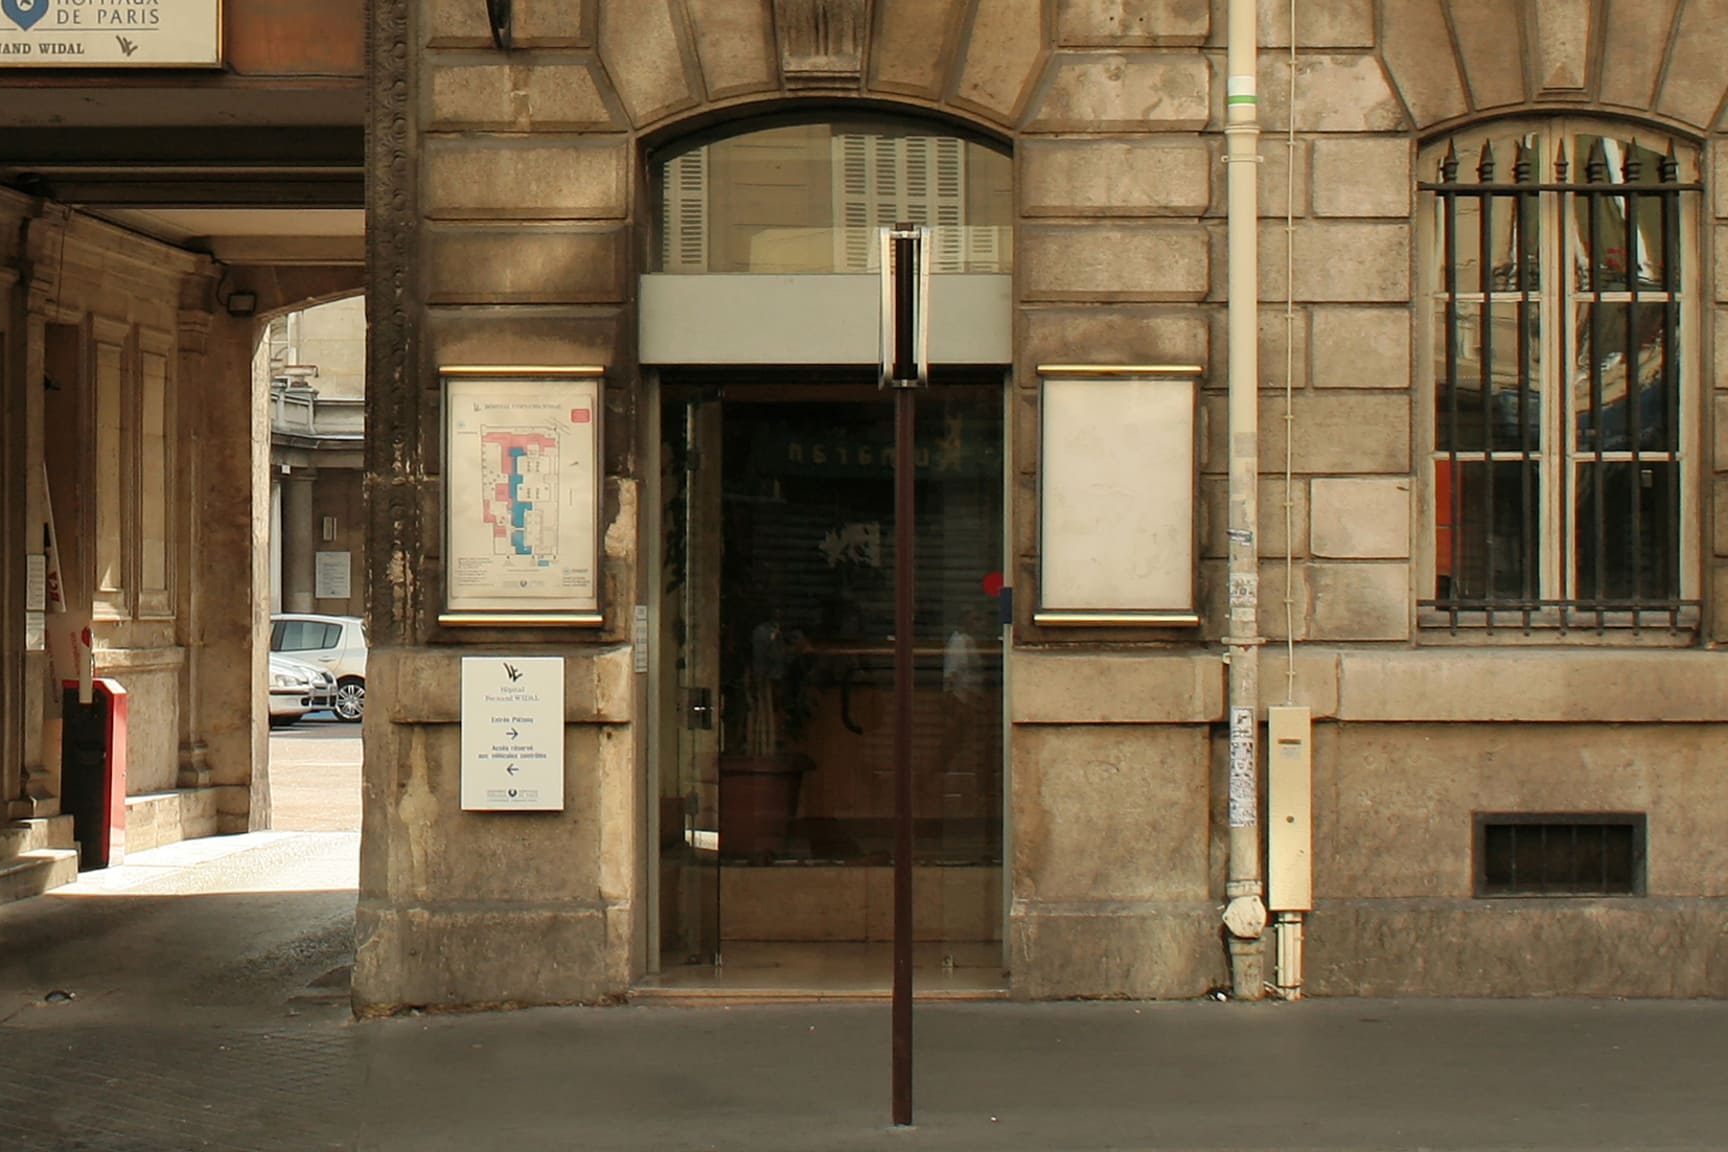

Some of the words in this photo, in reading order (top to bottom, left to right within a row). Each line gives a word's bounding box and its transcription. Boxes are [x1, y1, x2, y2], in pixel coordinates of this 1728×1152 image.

[57, 9, 81, 24] DE
[97, 9, 160, 24] PARIS
[39, 43, 85, 55] WIDAL
